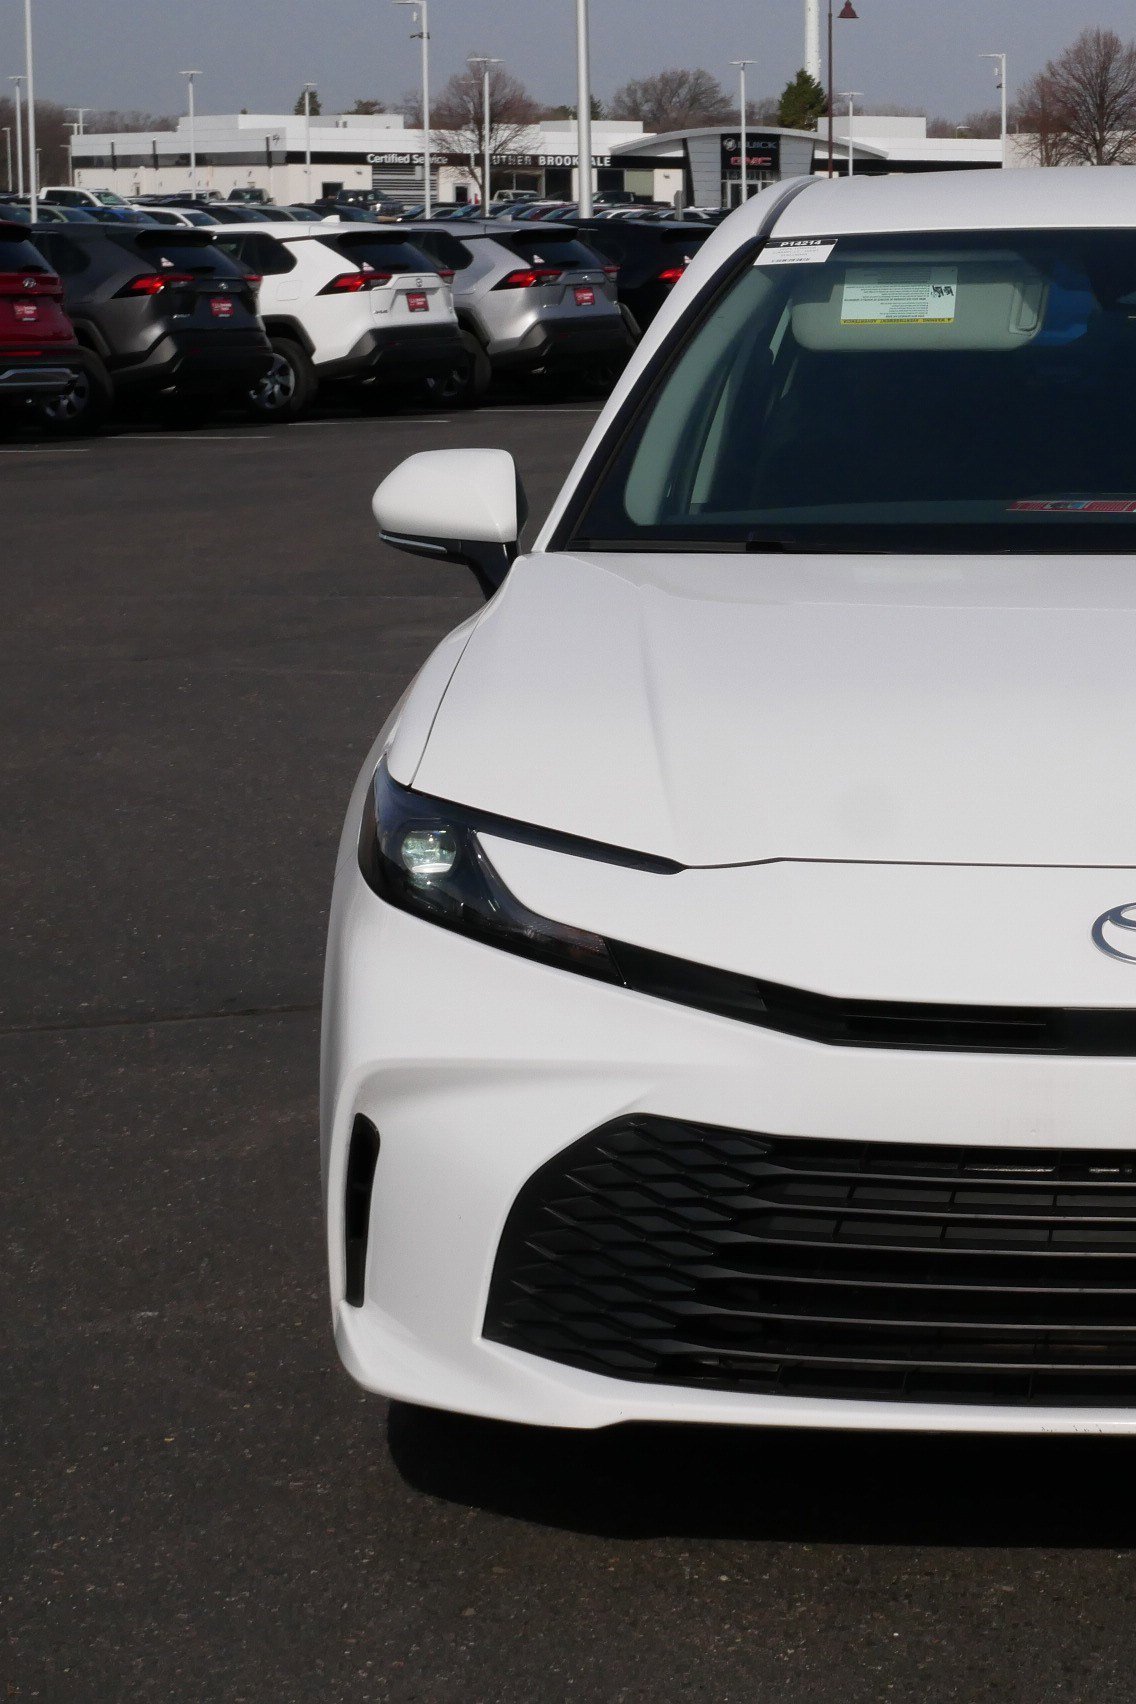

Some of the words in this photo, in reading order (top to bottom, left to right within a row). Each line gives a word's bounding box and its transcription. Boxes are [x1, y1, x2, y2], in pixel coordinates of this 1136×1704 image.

[367, 153, 411, 164] Certified
[412, 154, 449, 164] Sevice
[491, 155, 532, 166] UTHER
[538, 155, 612, 167] BROOKALE
